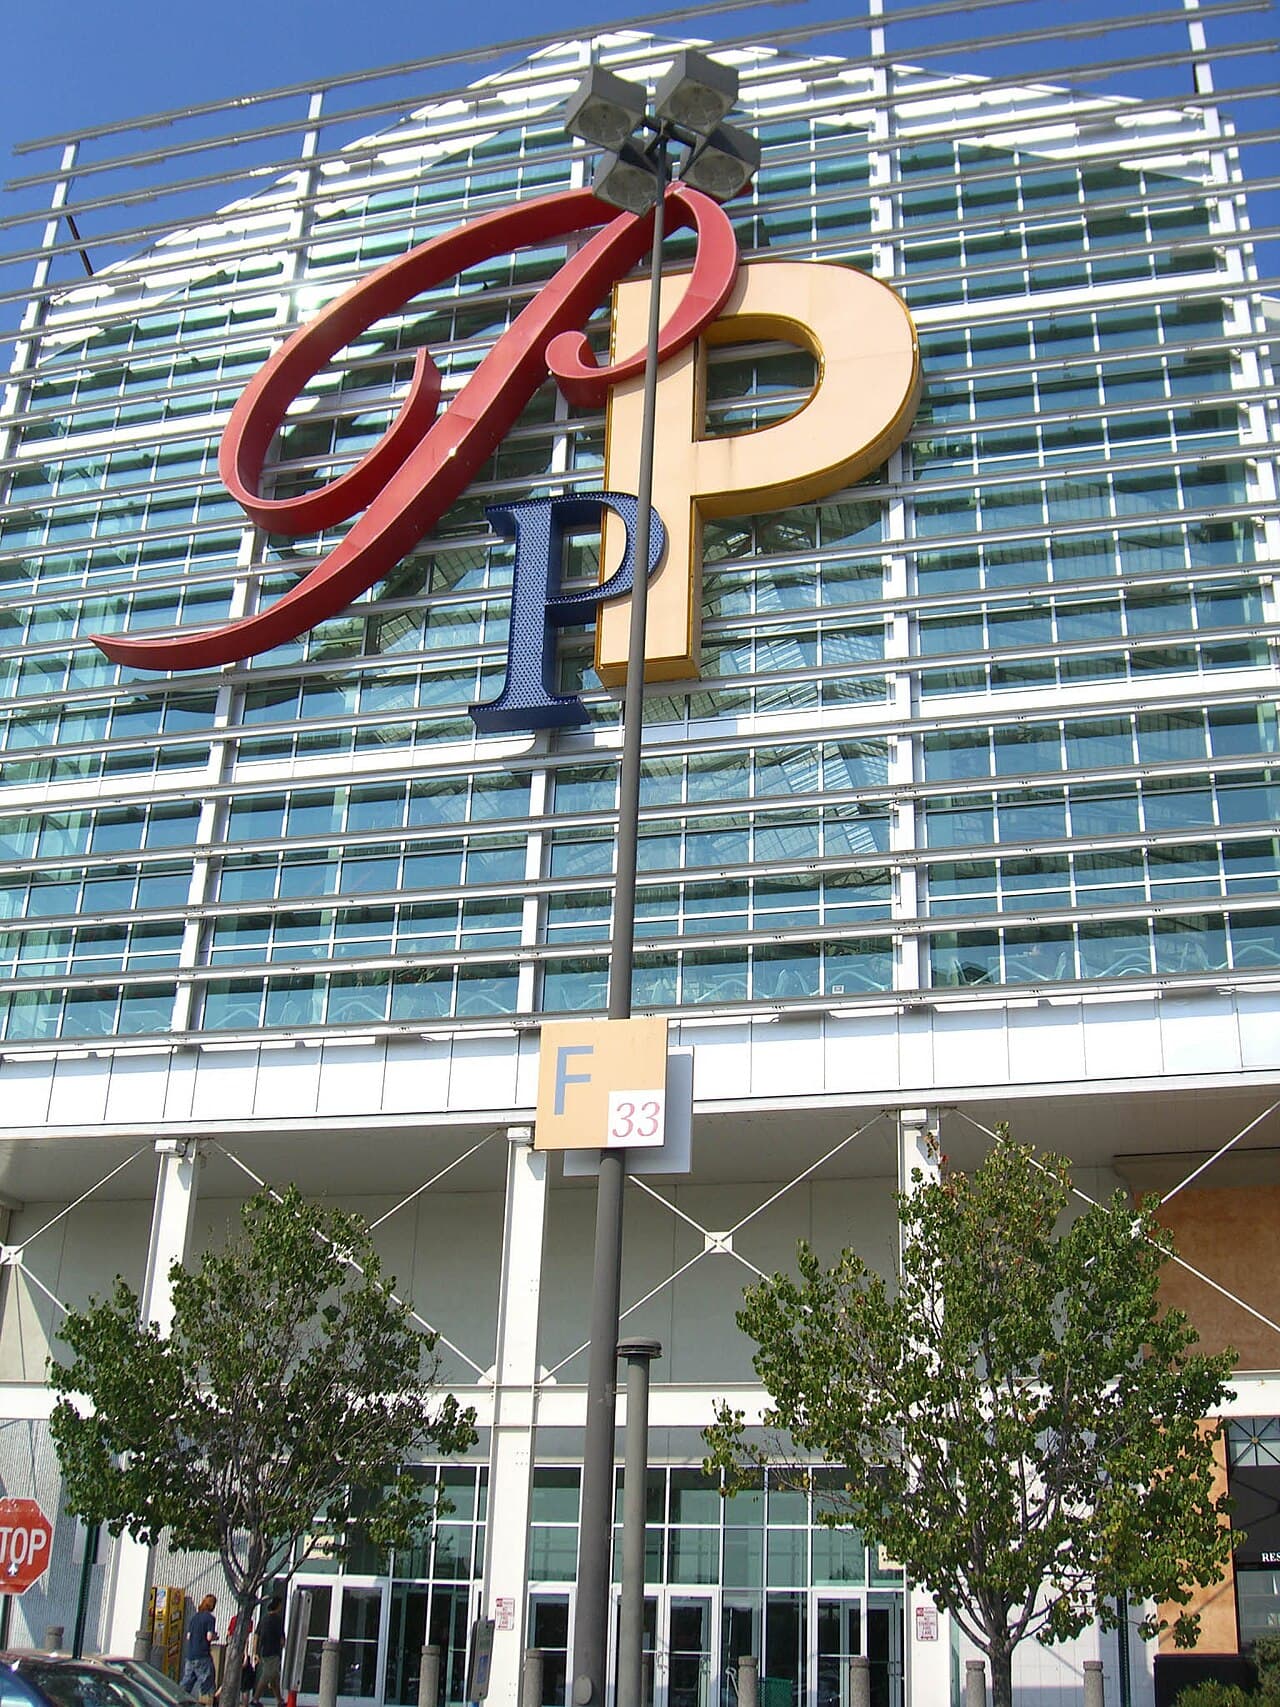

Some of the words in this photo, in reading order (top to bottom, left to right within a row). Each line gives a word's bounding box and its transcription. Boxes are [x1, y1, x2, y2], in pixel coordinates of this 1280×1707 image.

[470, 491, 666, 732] P
[554, 1045, 594, 1116] F
[611, 1101, 661, 1138] 33
